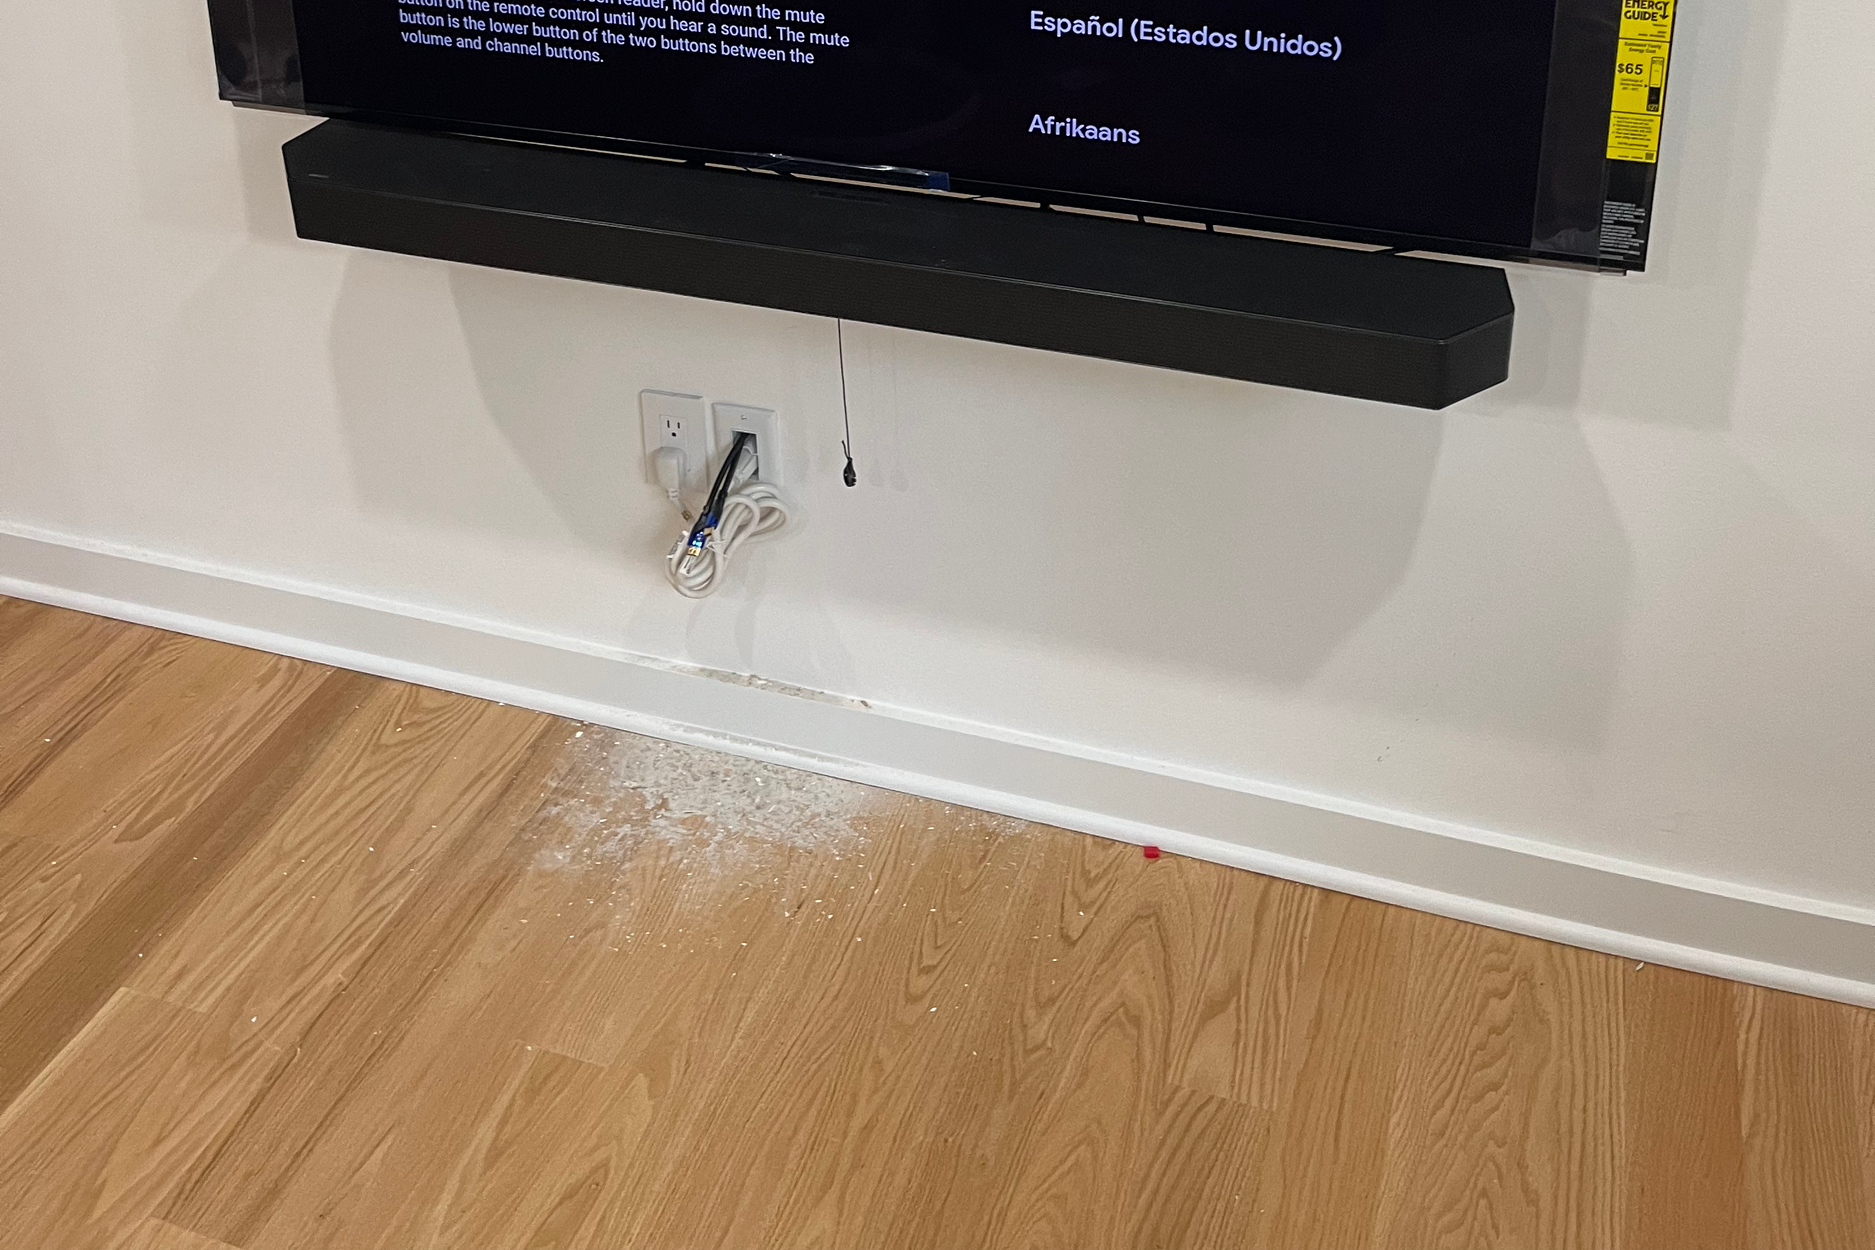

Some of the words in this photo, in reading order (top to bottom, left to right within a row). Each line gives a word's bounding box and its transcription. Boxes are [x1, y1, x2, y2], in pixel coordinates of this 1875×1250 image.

[709, 0, 753, 18] down
[755, 3, 781, 20] the
[785, 9, 826, 25] mute
[1623, 10, 1658, 22] GUIDE
[1624, 0, 1670, 11] ENERGY
[399, 8, 445, 27] button
[447, 13, 461, 29] is
[462, 15, 486, 31] the
[488, 17, 529, 36] lower
[532, 21, 580, 41] button
[582, 27, 599, 43] of
[600, 29, 626, 46] the
[628, 33, 657, 49] two
[660, 34, 718, 55] buttons
[720, 40, 786, 62] between
[788, 47, 815, 65] the
[493, 2, 546, 18] remote
[548, 7, 600, 23] control
[603, 11, 636, 27] until
[638, 15, 667, 31] you
[669, 15, 704, 33] hear
[707, 22, 717, 35] a
[720, 23, 772, 40] sound.
[775, 26, 806, 43] The
[809, 32, 850, 48] mute
[1030, 10, 1124, 38] Español
[1130, 17, 1238, 49] (Estados
[1244, 29, 1342, 61] Unidos)
[400, 29, 453, 47] volume
[455, 35, 482, 50] and
[485, 37, 542, 57] channel
[544, 42, 604, 63] buttons.
[1616, 63, 1643, 76] $65
[1028, 113, 1141, 145] Afrikaans
